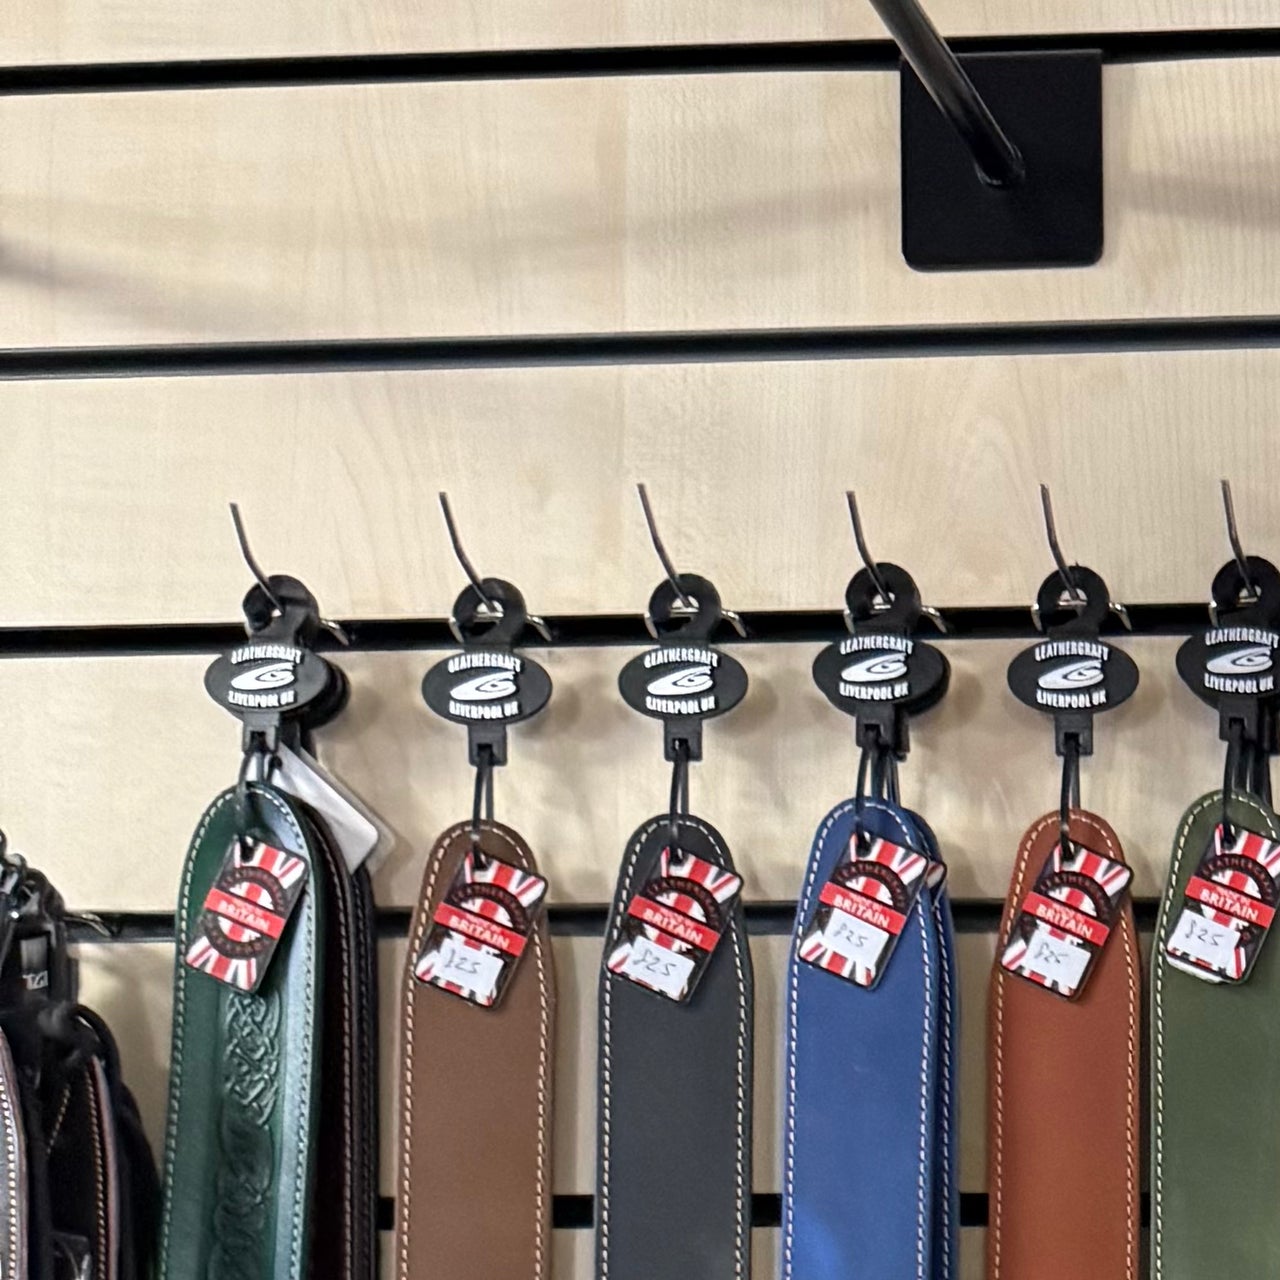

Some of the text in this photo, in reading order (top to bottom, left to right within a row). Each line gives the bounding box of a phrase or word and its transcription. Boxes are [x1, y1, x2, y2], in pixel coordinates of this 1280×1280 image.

[839, 681, 893, 700] LIVERPOOL
[1036, 689, 1107, 708] LIVERPOOL UK
[1204, 673, 1274, 693] LIVERPOOL UK
[833, 894, 890, 927] BRITAIN
[1200, 888, 1259, 921] BRITAIN
[450, 915, 511, 949] BRITAIN
[642, 908, 703, 941] BRITAIN
[1036, 904, 1094, 939] BRITAIN
